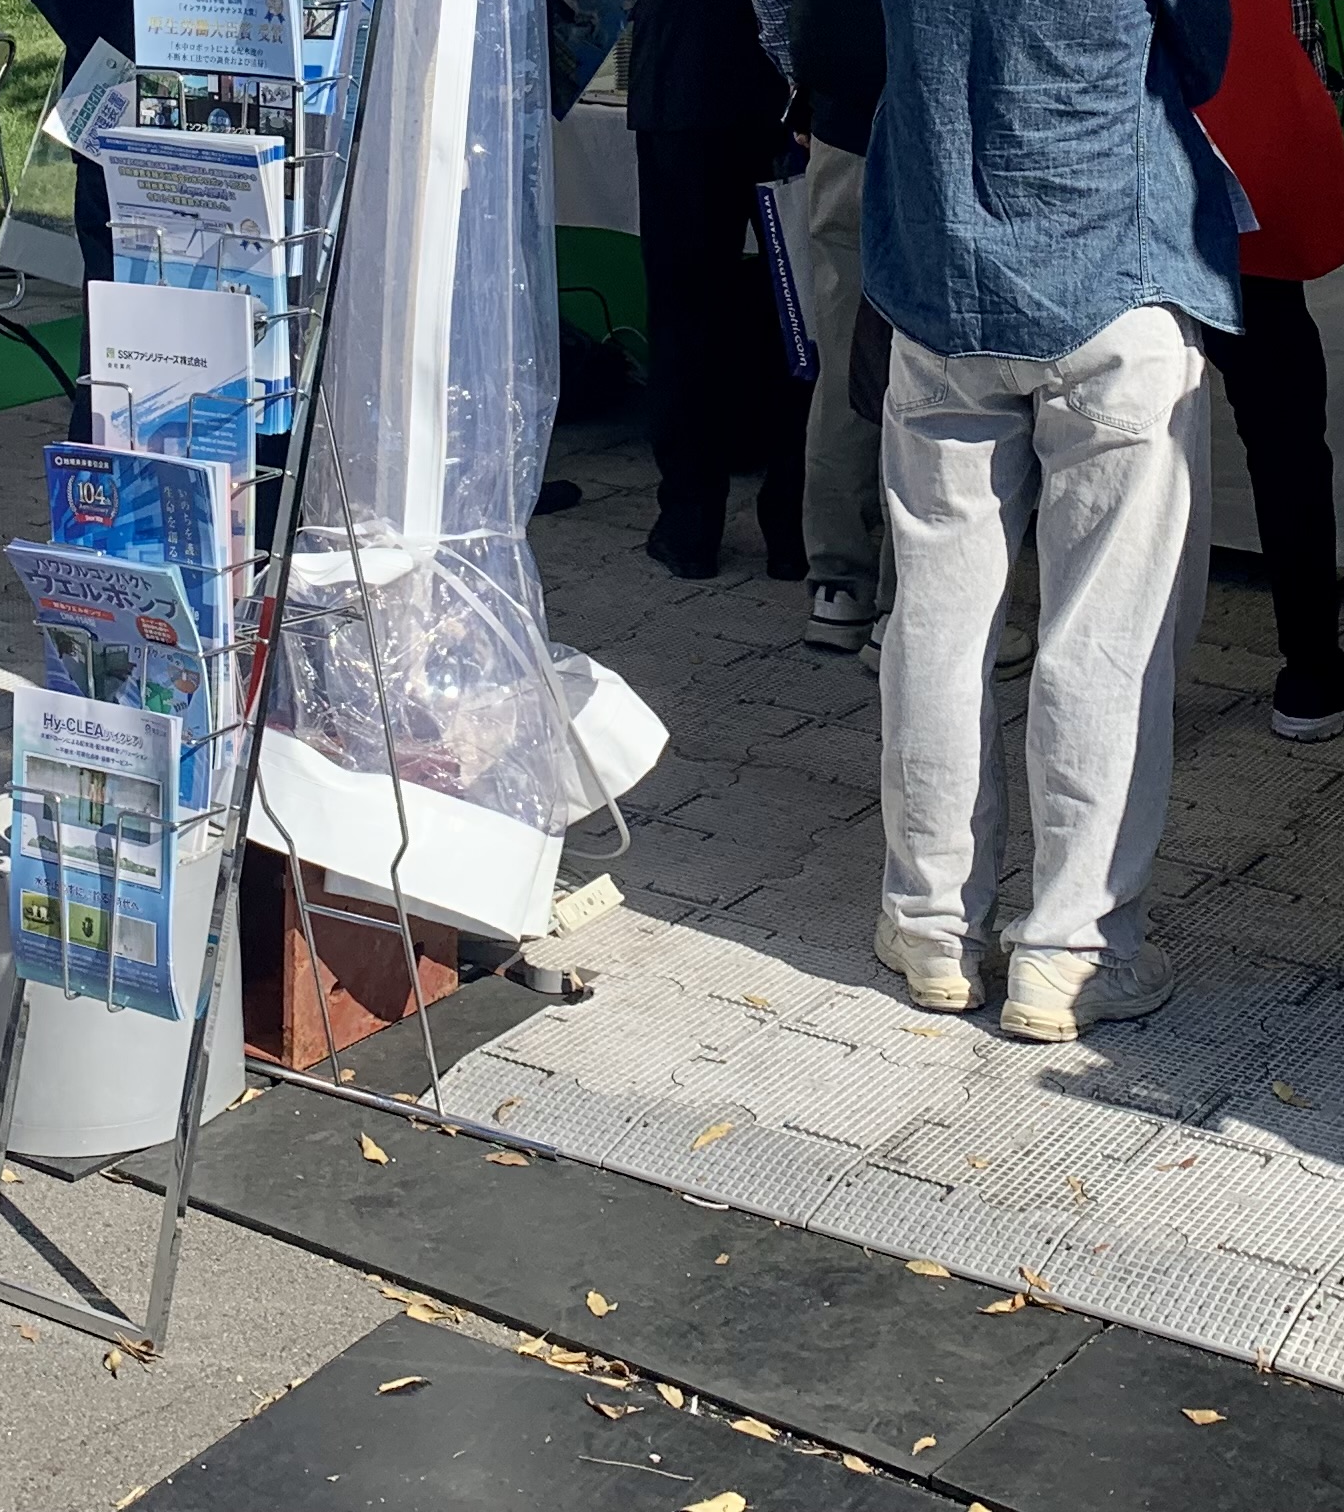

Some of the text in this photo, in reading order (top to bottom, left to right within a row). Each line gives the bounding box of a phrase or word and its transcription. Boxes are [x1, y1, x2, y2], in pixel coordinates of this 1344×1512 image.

[36, 558, 152, 591] パワフルコンパクト
[43, 712, 105, 739] Hy-CLEA
